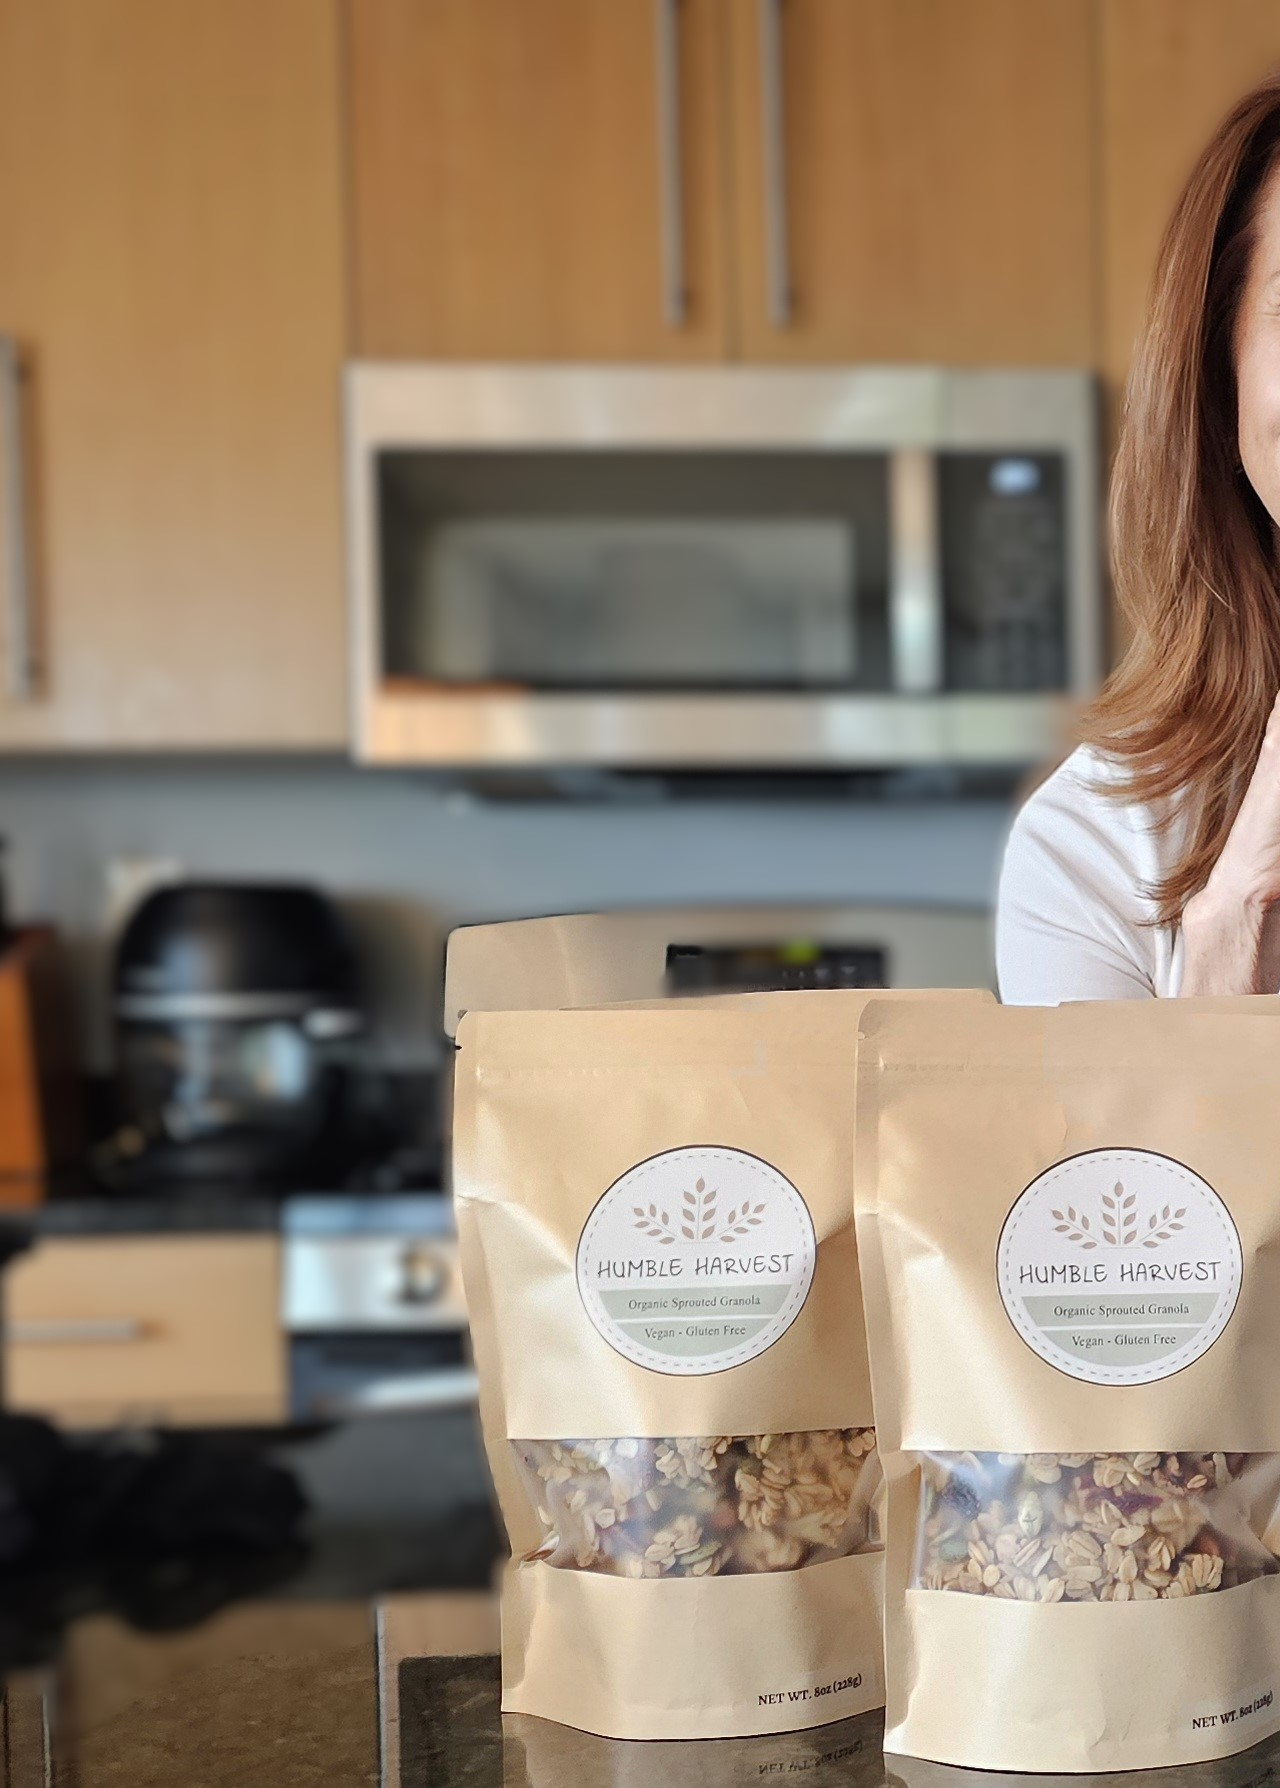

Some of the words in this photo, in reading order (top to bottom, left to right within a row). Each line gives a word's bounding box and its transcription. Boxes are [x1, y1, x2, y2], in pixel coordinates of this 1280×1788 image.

[598, 1258, 683, 1278] HUMBLE
[695, 1254, 794, 1276] HARVEST
[1019, 1264, 1108, 1284] HUMBLE
[1120, 1261, 1221, 1281] HARVEST
[628, 1298, 668, 1311] Organic
[671, 1296, 717, 1311] Sprouted
[720, 1295, 761, 1306] Granola
[1054, 1304, 1096, 1318] Organic
[1099, 1304, 1145, 1318] Sprouted
[1148, 1303, 1189, 1314] Granola
[645, 1327, 675, 1340] Vegan
[685, 1325, 720, 1336] Gluten
[723, 1325, 746, 1336] Free
[1072, 1335, 1104, 1348] Vegan
[1114, 1334, 1150, 1346] Gluten
[1153, 1333, 1176, 1344] Free
[758, 1692, 785, 1705] NET
[788, 1689, 812, 1702] WT.
[814, 1686, 832, 1698] 8oz
[833, 1673, 862, 1693] (228g)
[1192, 1715, 1218, 1729] NET
[1220, 1710, 1239, 1724] WT.
